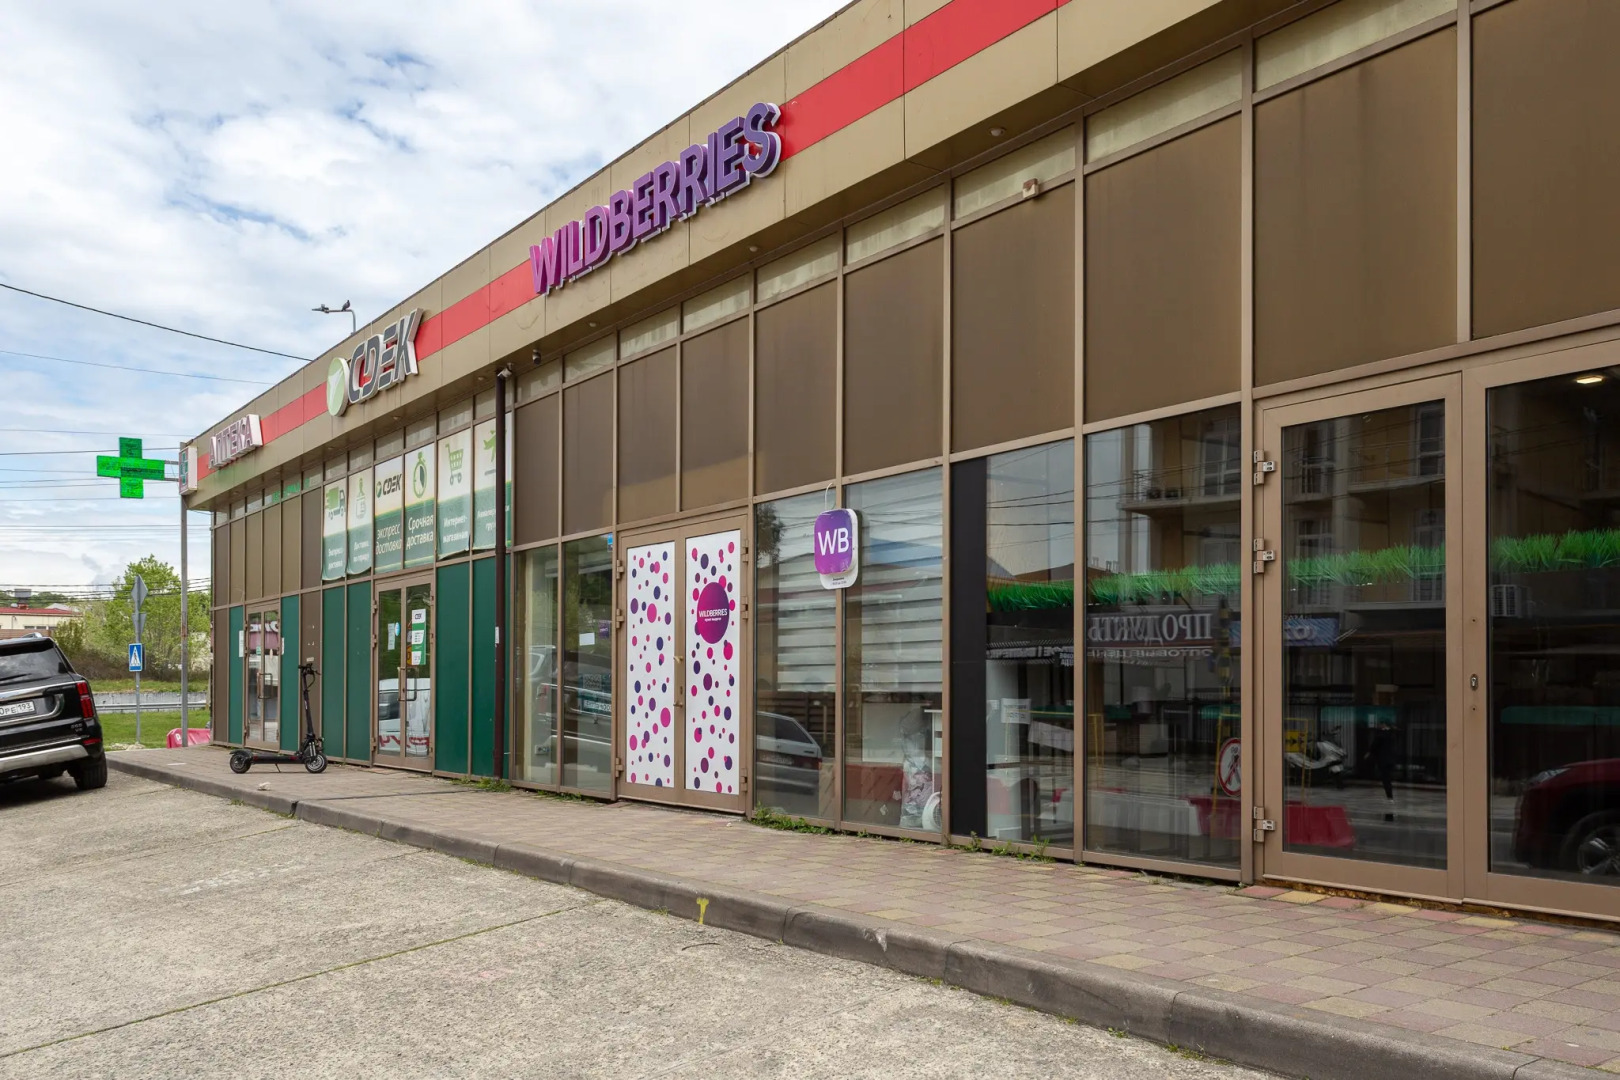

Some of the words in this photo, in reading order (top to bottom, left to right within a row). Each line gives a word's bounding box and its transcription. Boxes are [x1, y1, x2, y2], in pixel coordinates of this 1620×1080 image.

[530, 102, 781, 295] WILDBERRIES
[208, 414, 261, 469] АПТЕКА
[407, 513, 434, 534] Срочная
[405, 530, 434, 550] доставка
[817, 527, 850, 557] WB
[698, 608, 728, 618] WILDBERRIES
